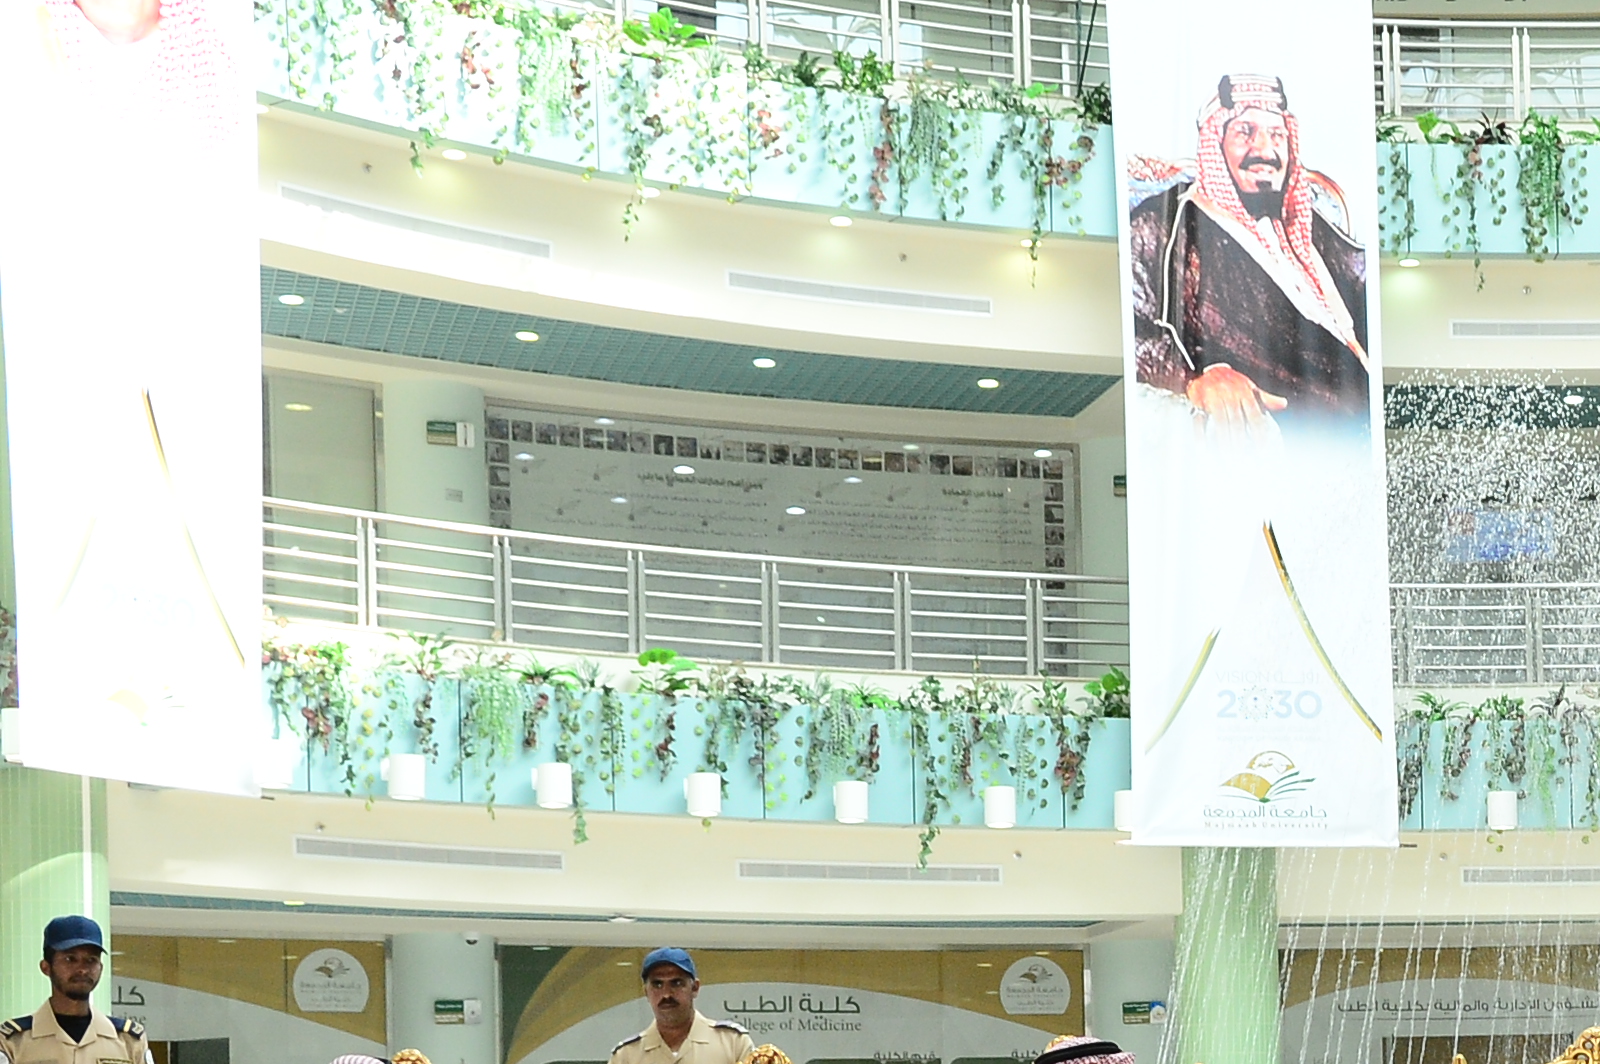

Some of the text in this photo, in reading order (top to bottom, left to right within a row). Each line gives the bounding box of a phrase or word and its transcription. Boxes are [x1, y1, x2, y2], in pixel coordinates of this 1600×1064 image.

[1215, 670, 1270, 684] VISION
[1203, 804, 1328, 821] جامعة المجمعة
[723, 993, 861, 1020] كلية الطب
[724, 1017, 862, 1034] ollege of Medicine
